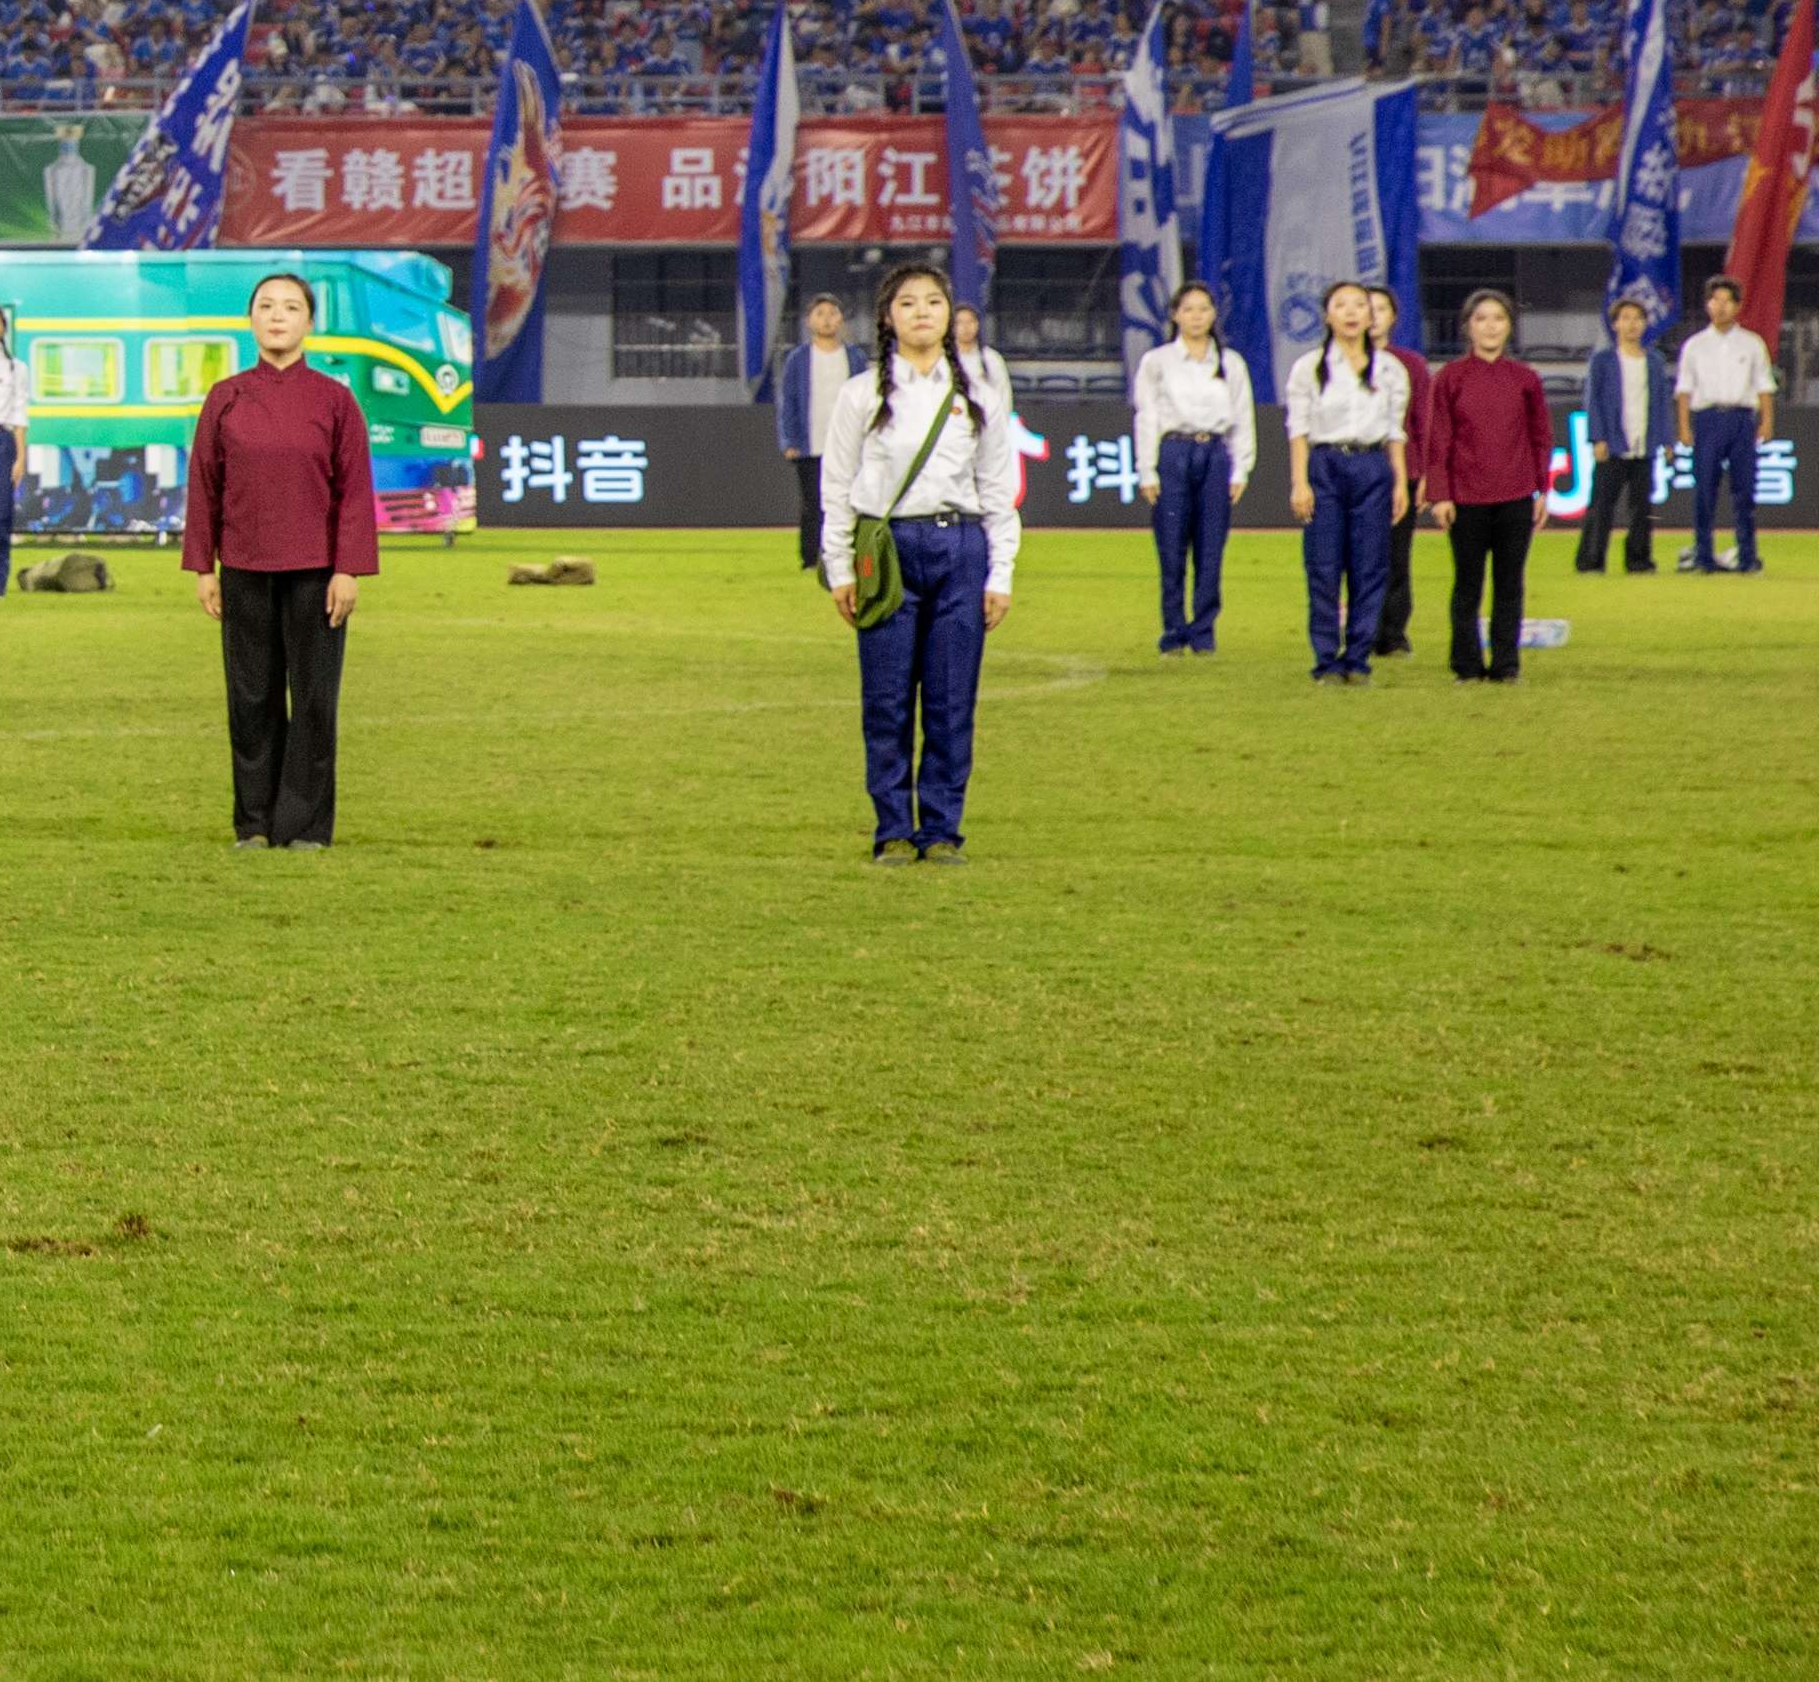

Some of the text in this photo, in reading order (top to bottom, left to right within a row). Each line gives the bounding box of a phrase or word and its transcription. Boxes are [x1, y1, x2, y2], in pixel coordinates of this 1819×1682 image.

[270, 147, 616, 211] 看赣超赛
[662, 145, 1087, 211] 品阳江饼
[500, 434, 648, 504] 抖音
